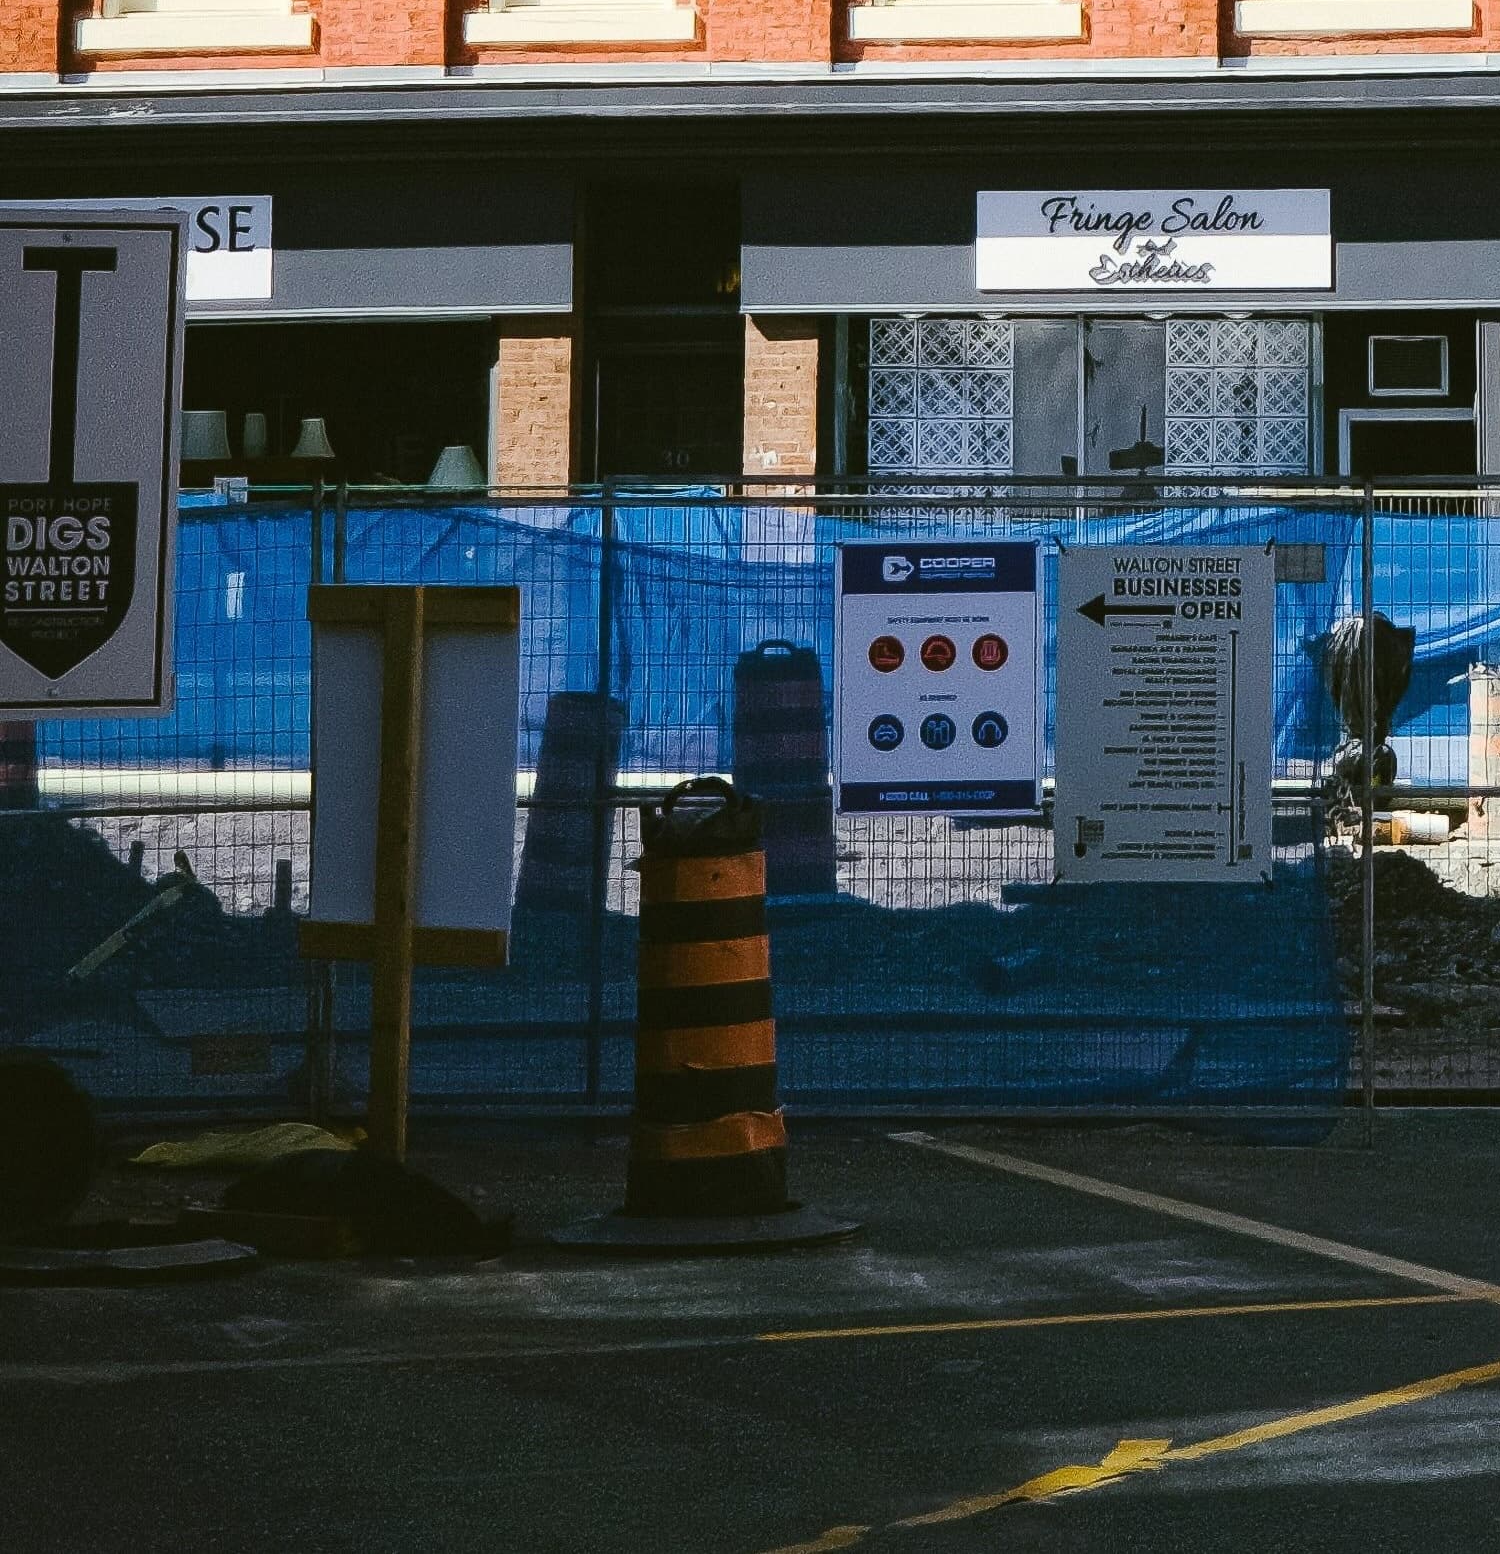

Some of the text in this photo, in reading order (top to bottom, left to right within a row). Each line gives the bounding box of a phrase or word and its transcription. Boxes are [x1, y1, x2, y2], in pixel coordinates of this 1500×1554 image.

[194, 205, 256, 253] SE
[1041, 195, 1265, 255] Fringe Salon
[8, 498, 112, 511] PORT HOPE
[7, 516, 110, 550] DIGS
[7, 556, 110, 575] WALTON
[920, 557, 995, 569] COOPER
[1114, 557, 1242, 573] WALTON STREET
[5, 580, 109, 601] STREET
[1113, 577, 1242, 596] BUSINESSES
[1180, 601, 1242, 620] OPEN
